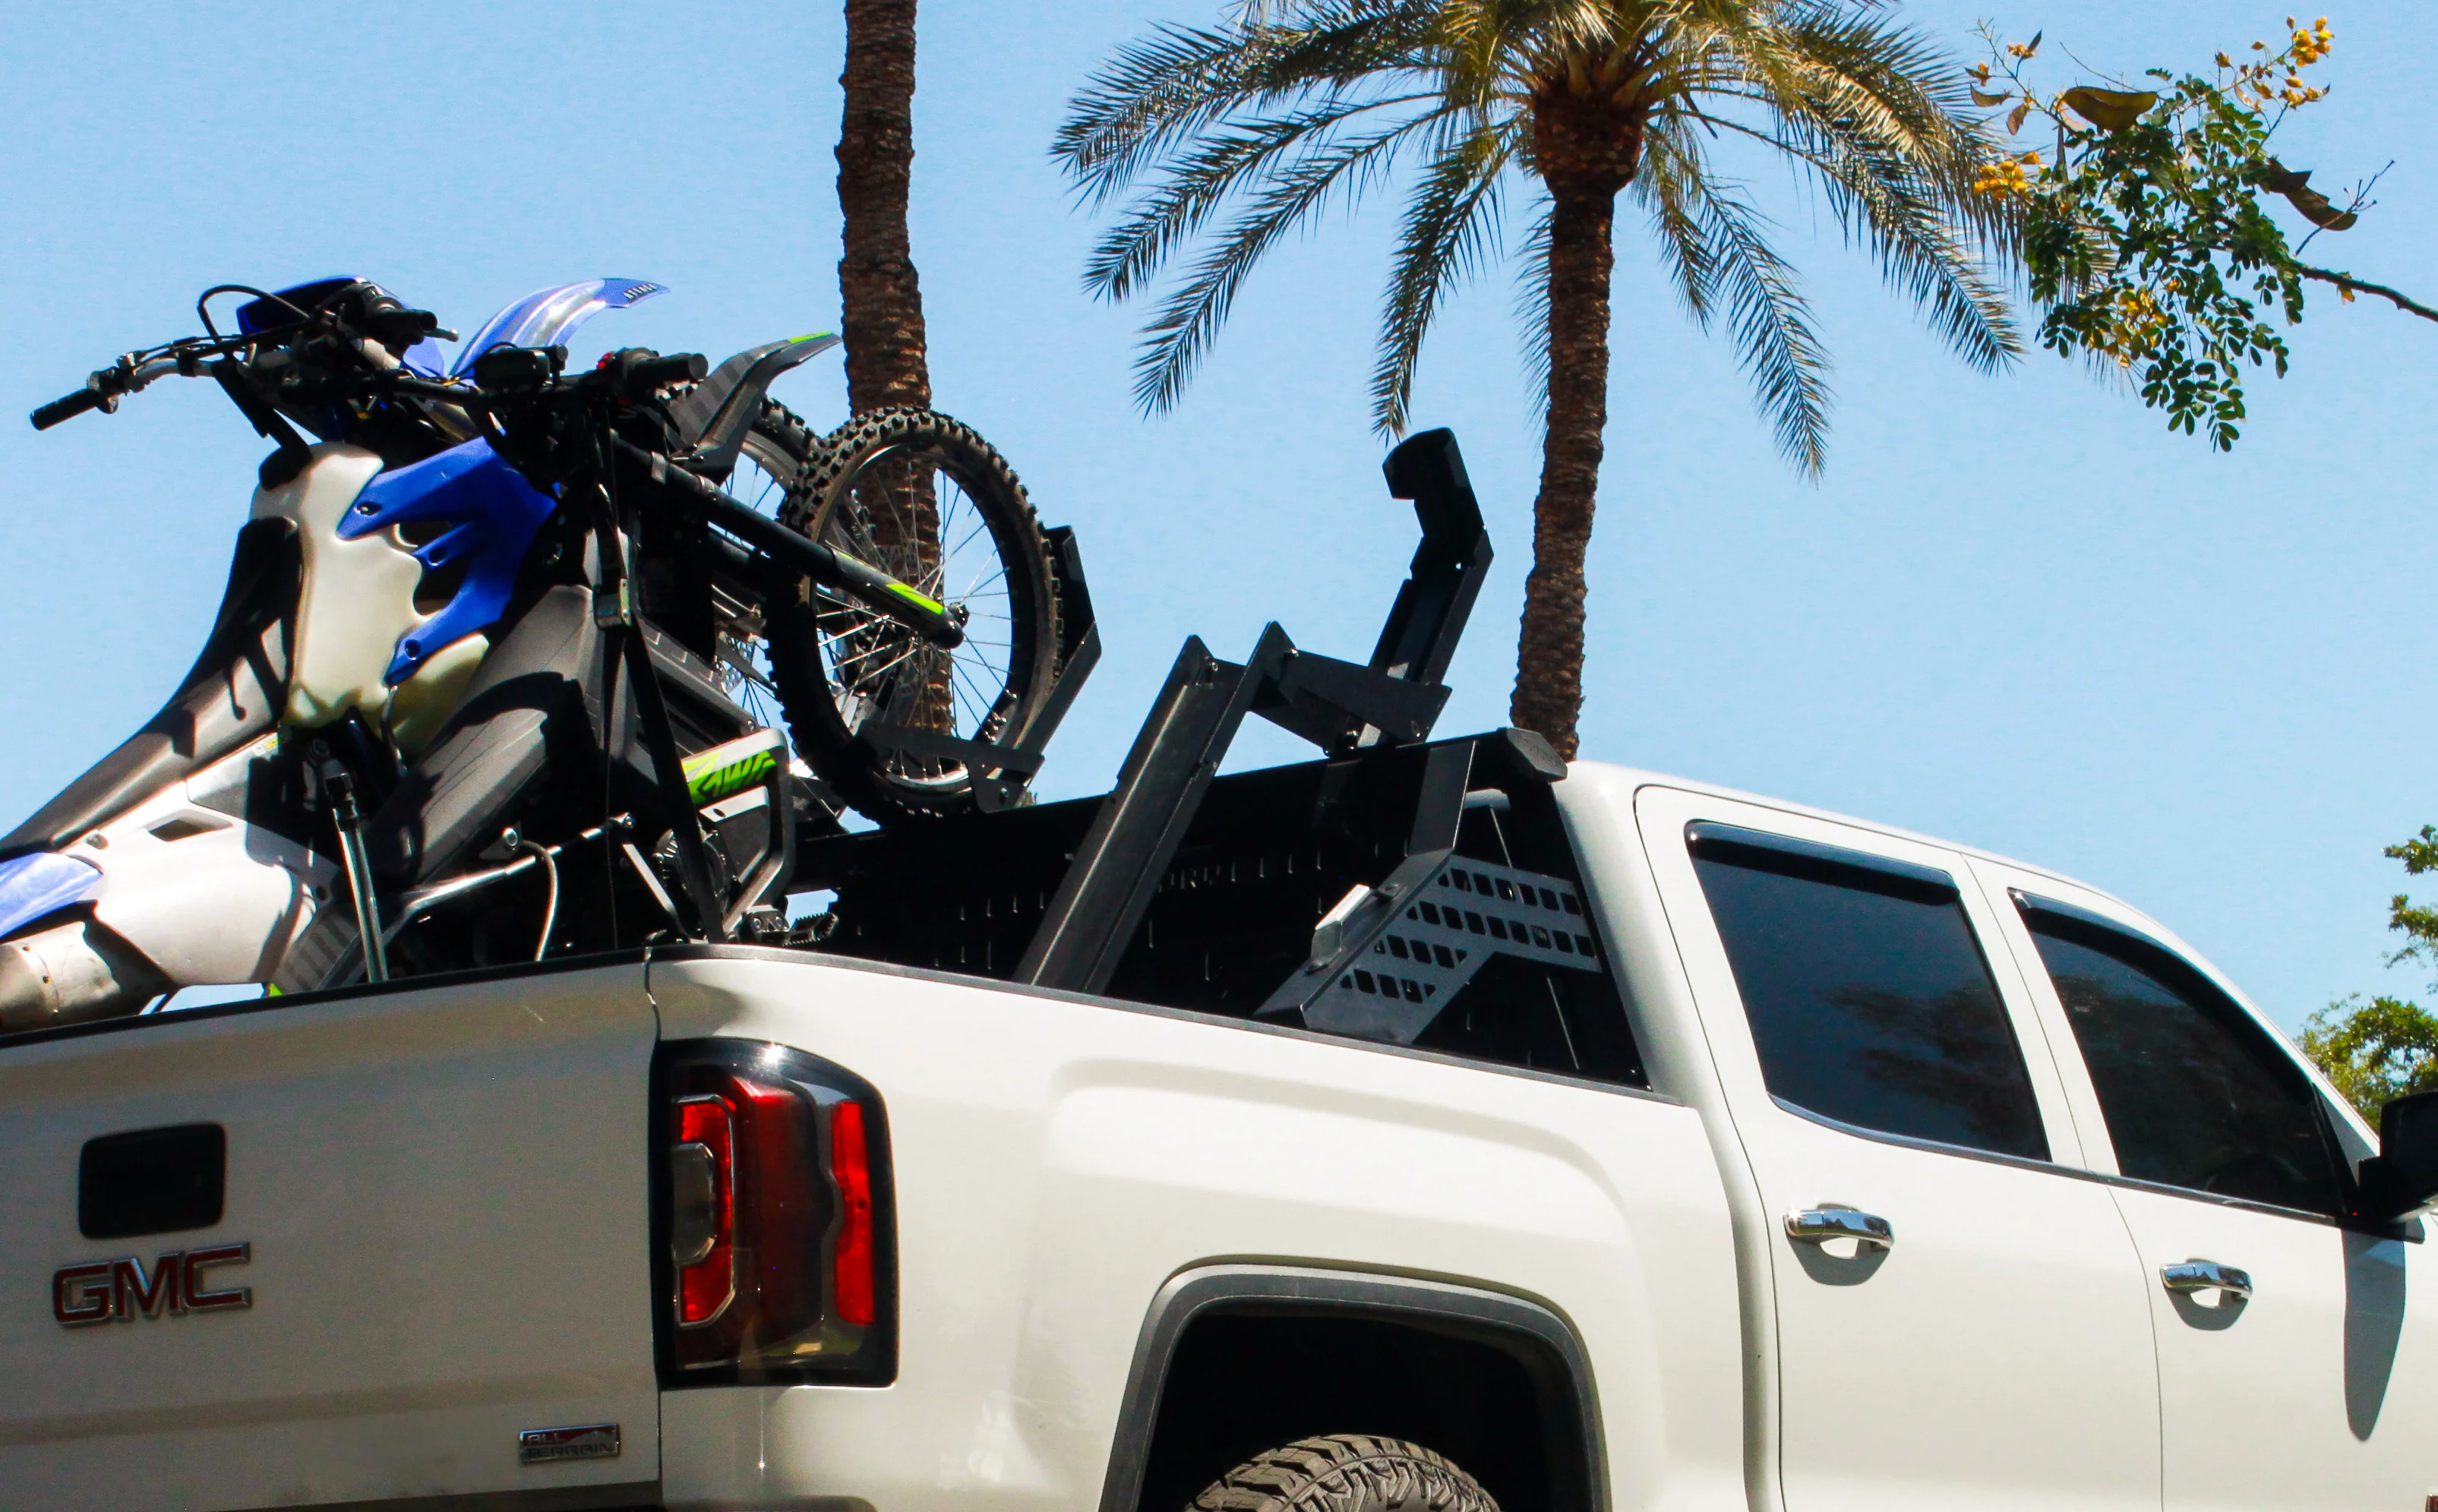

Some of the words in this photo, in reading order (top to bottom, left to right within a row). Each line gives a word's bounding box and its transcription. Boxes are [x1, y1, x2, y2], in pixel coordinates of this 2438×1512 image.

[52, 1242, 252, 1326] GMC
[527, 1432, 565, 1446] ALL
[523, 1442, 615, 1458] TERRAIN
